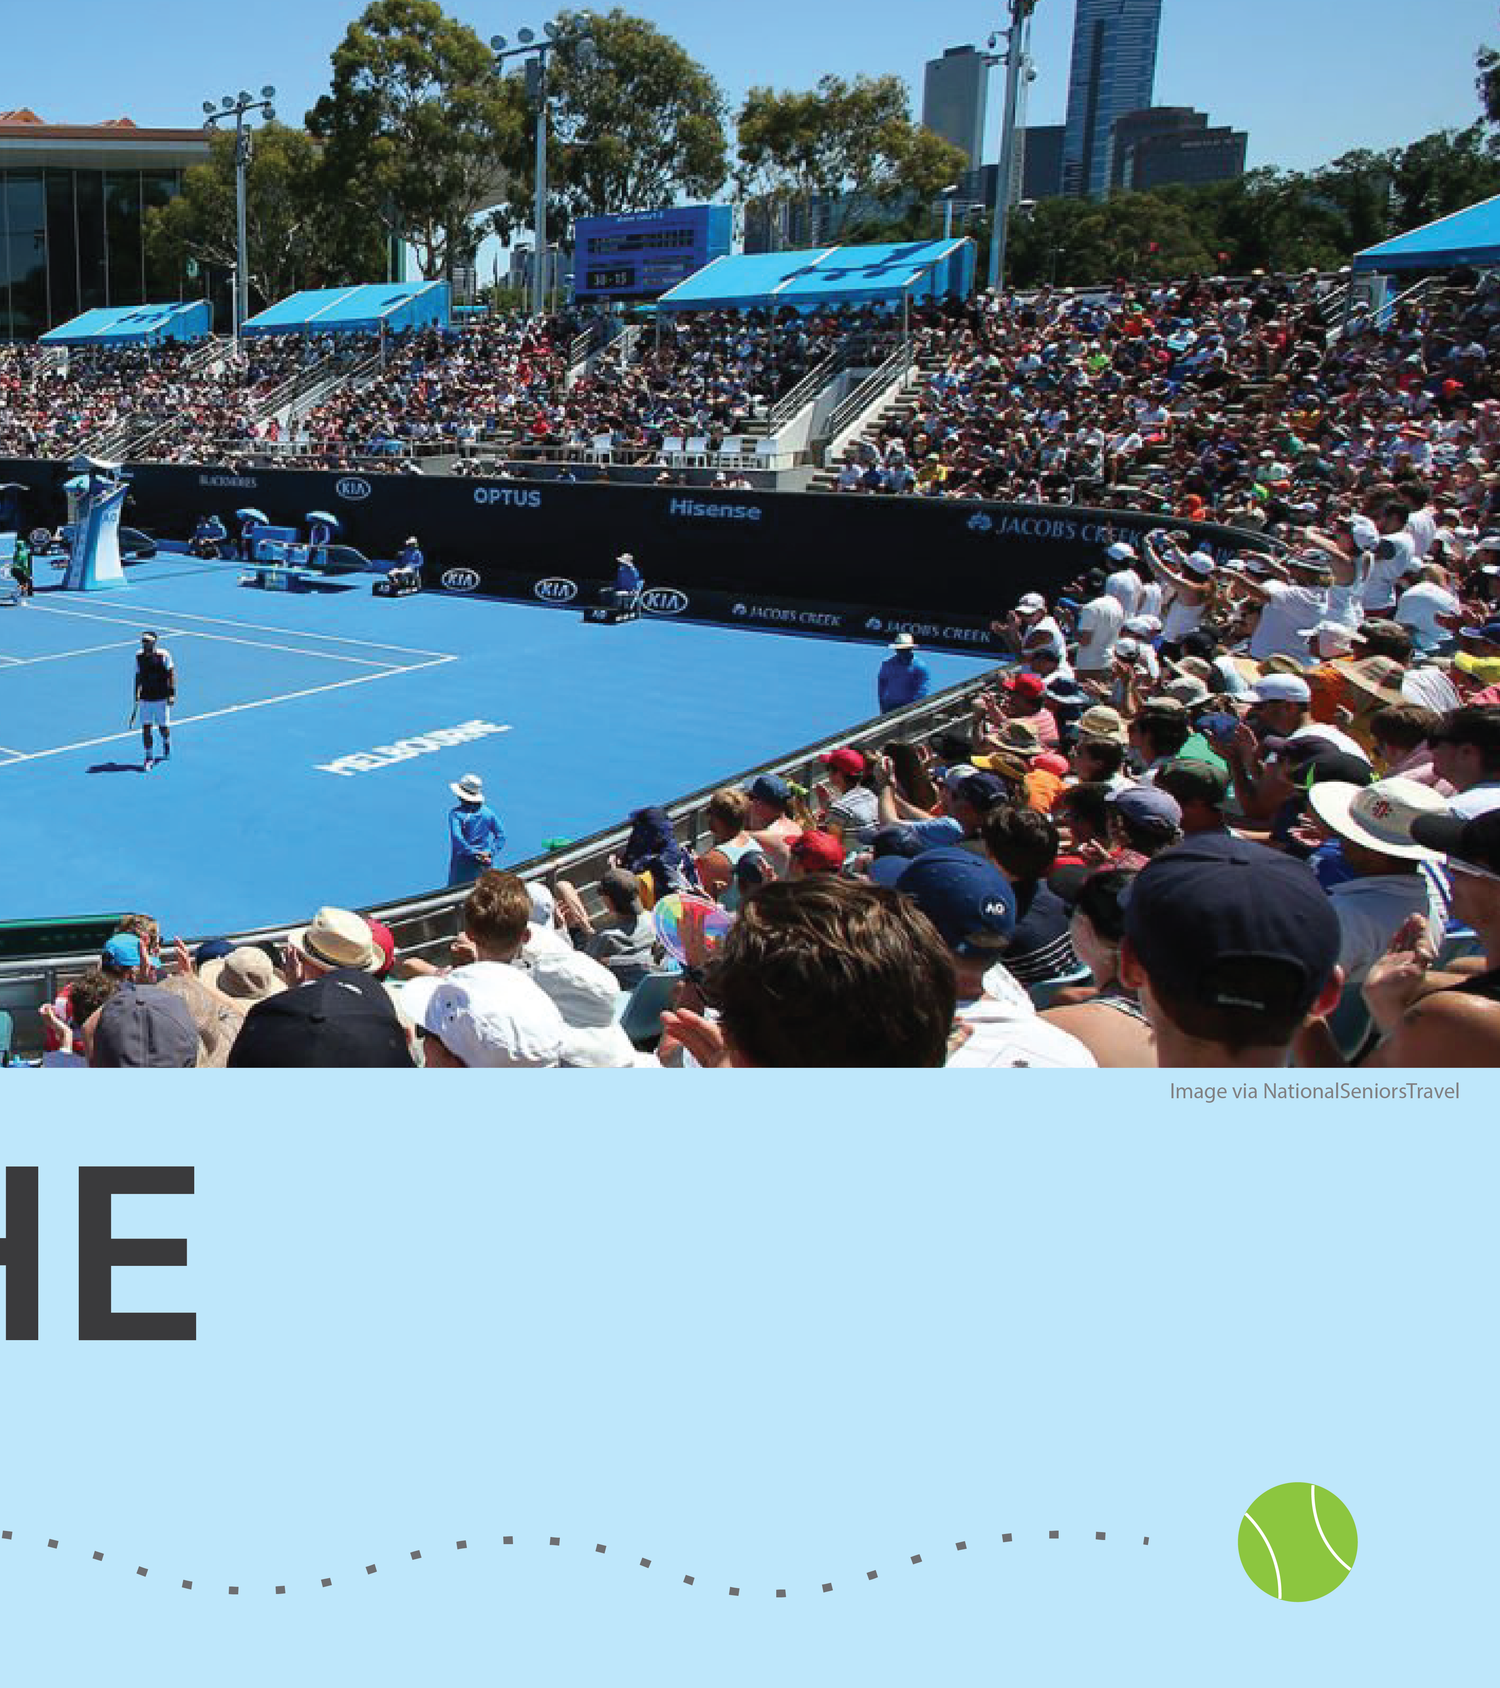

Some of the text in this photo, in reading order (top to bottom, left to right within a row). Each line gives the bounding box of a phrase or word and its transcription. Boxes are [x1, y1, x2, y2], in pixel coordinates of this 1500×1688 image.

[339, 479, 368, 497] KIA
[474, 488, 541, 508] OPTUS
[670, 498, 762, 520] Hisense
[446, 571, 475, 588] KIA
[539, 580, 572, 599] KIA
[646, 591, 681, 611] KIA
